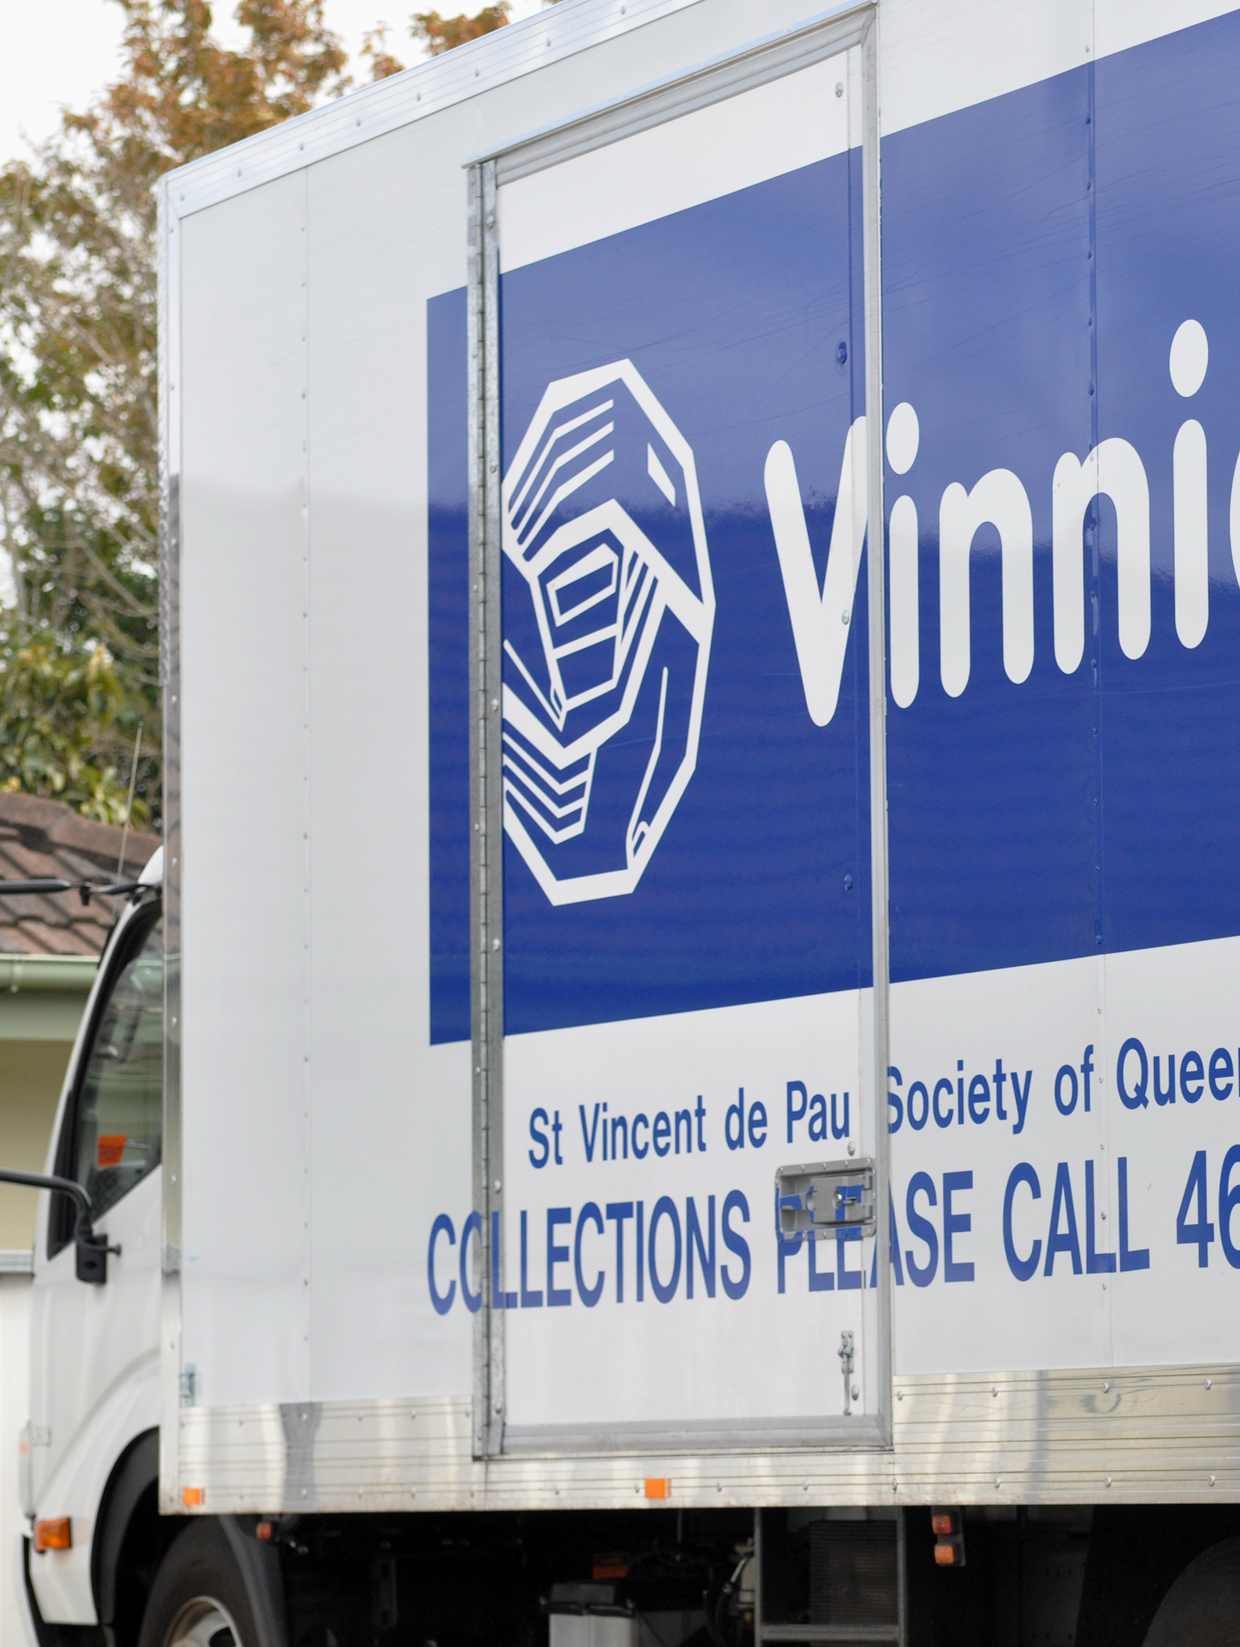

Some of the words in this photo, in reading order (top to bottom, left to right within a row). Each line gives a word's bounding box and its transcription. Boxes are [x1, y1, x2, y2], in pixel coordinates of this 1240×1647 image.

[528, 1107, 563, 1169] St
[579, 1096, 707, 1163] Vincent
[725, 1088, 768, 1151] de
[887, 1059, 1032, 1135] Society
[1054, 1045, 1094, 1116] of
[427, 1189, 752, 1316] COLLECTIONS
[1002, 1157, 1150, 1282] CALL
